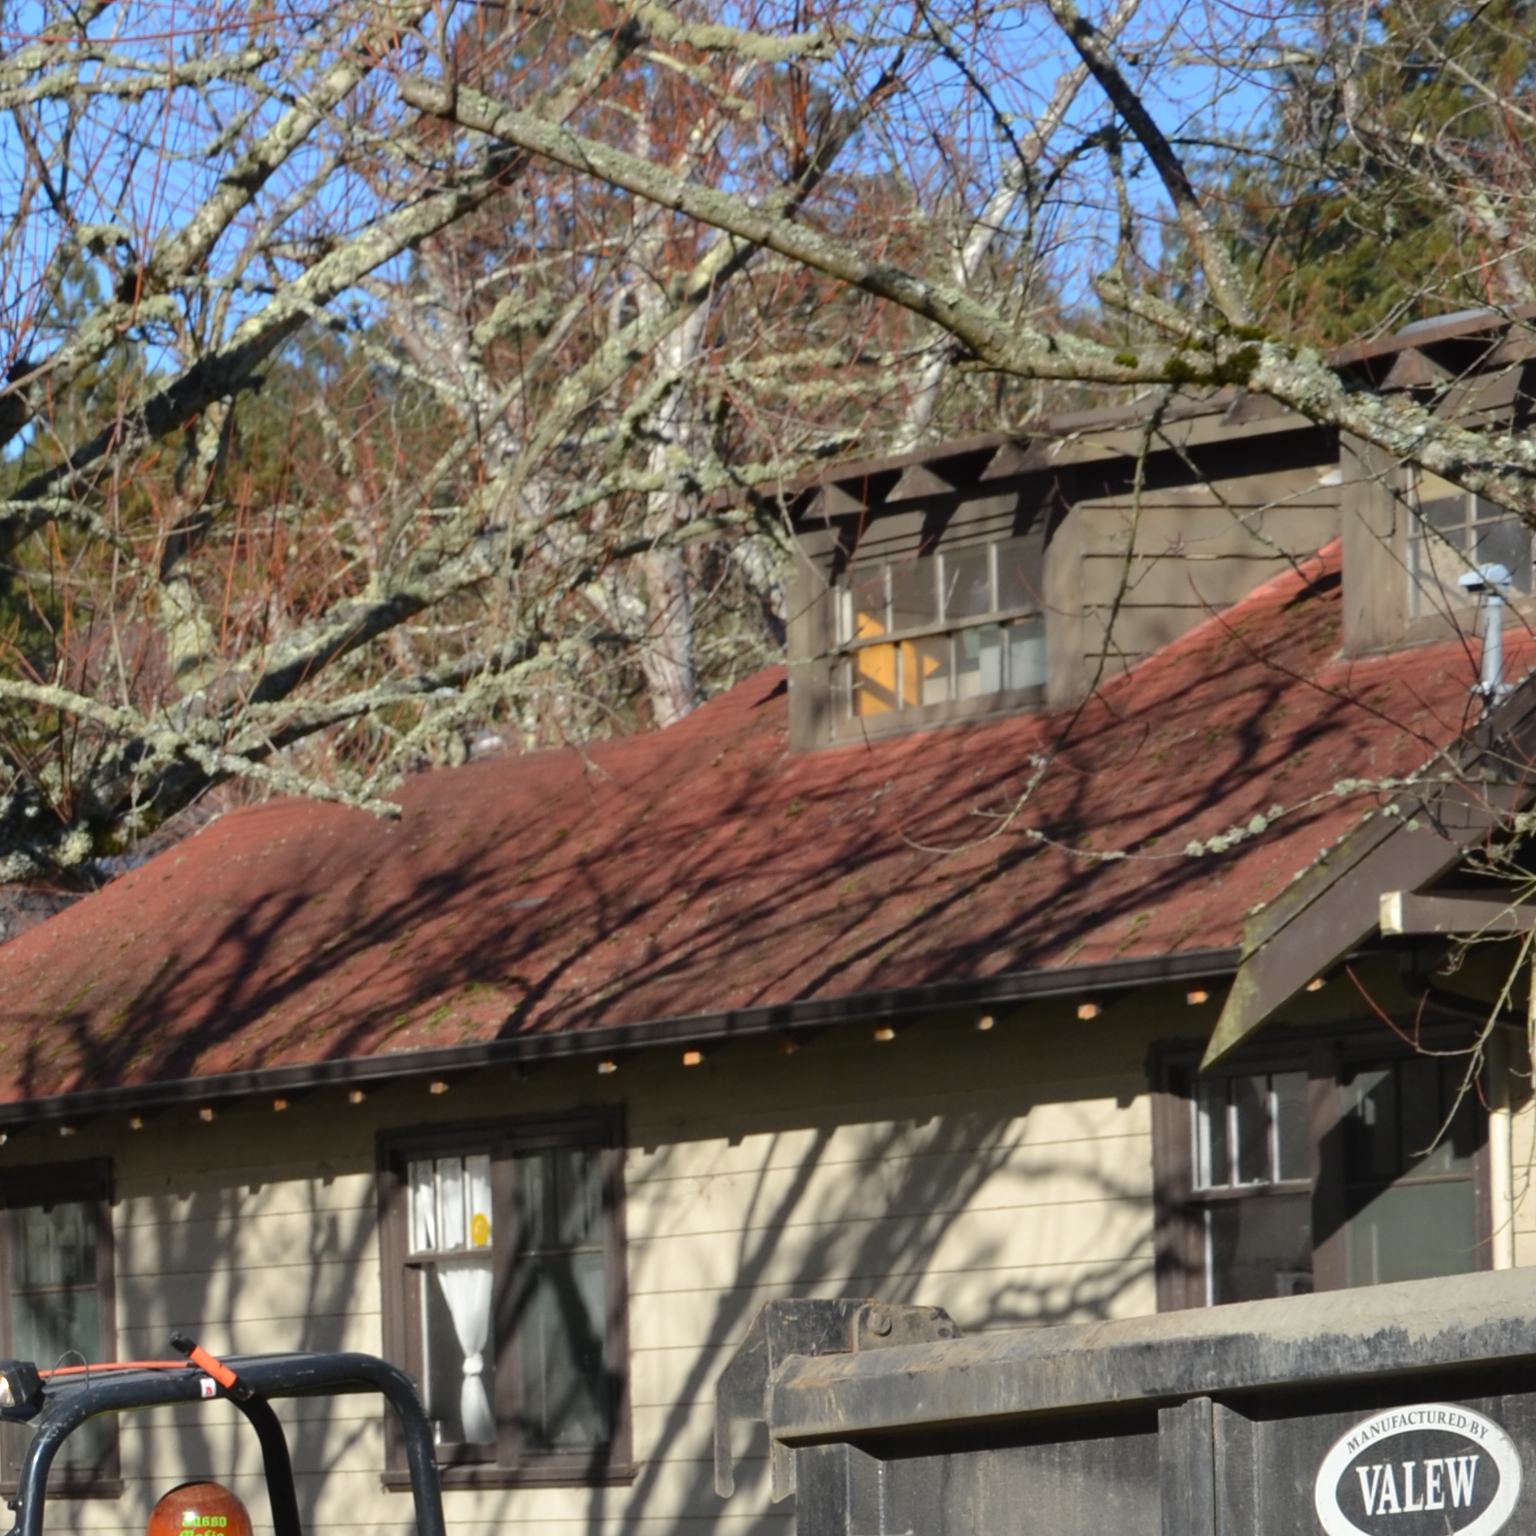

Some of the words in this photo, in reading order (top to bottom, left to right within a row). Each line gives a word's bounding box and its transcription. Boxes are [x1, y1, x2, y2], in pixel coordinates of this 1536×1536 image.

[1346, 1410, 1466, 1454] MANUFACTURED
[1470, 1420, 1489, 1440] BY
[1355, 1455, 1479, 1516] VALEW
